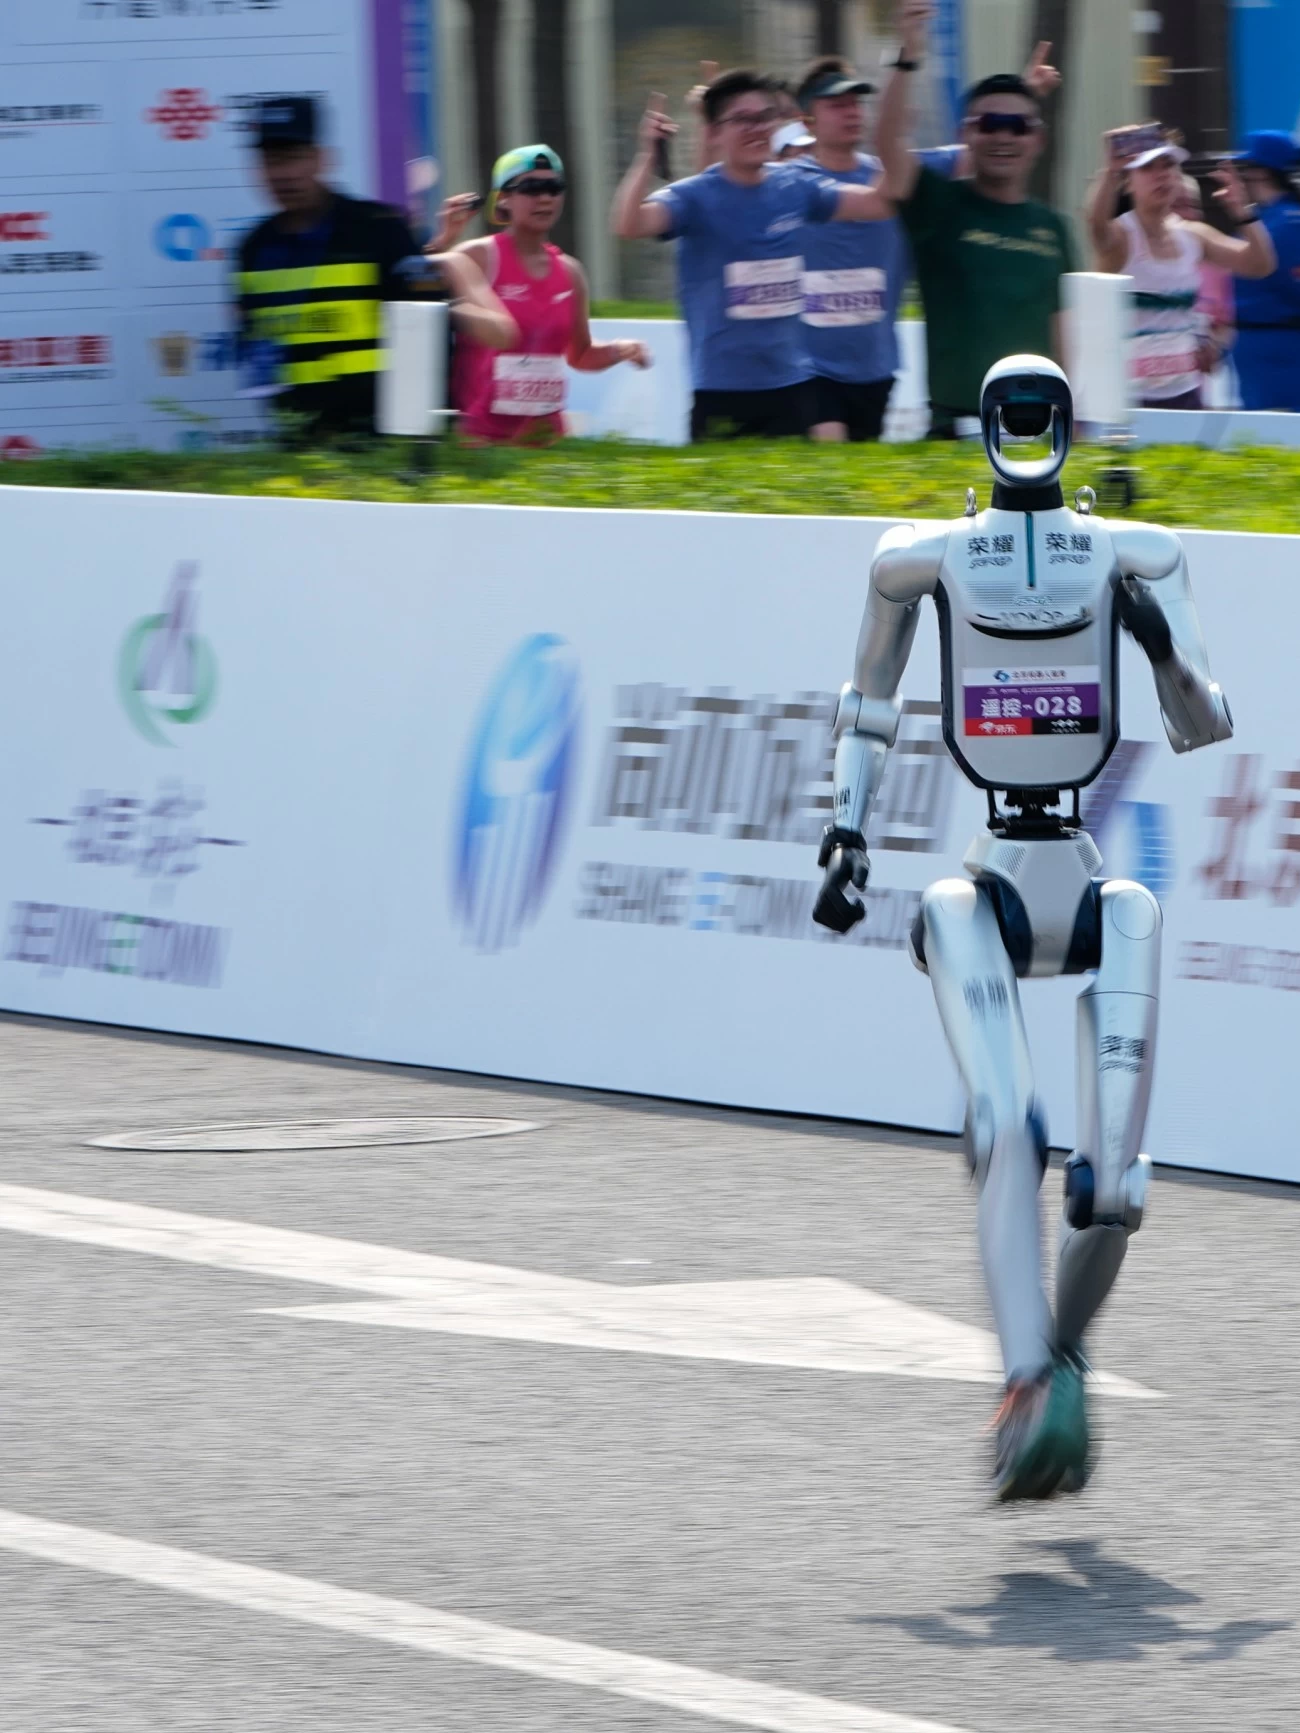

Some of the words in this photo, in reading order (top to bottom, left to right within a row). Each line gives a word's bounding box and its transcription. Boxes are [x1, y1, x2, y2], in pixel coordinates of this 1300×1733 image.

[967, 534, 1016, 556] 荣耀
[1044, 531, 1093, 552] 荣耀
[981, 695, 1083, 718] 遥控-028
